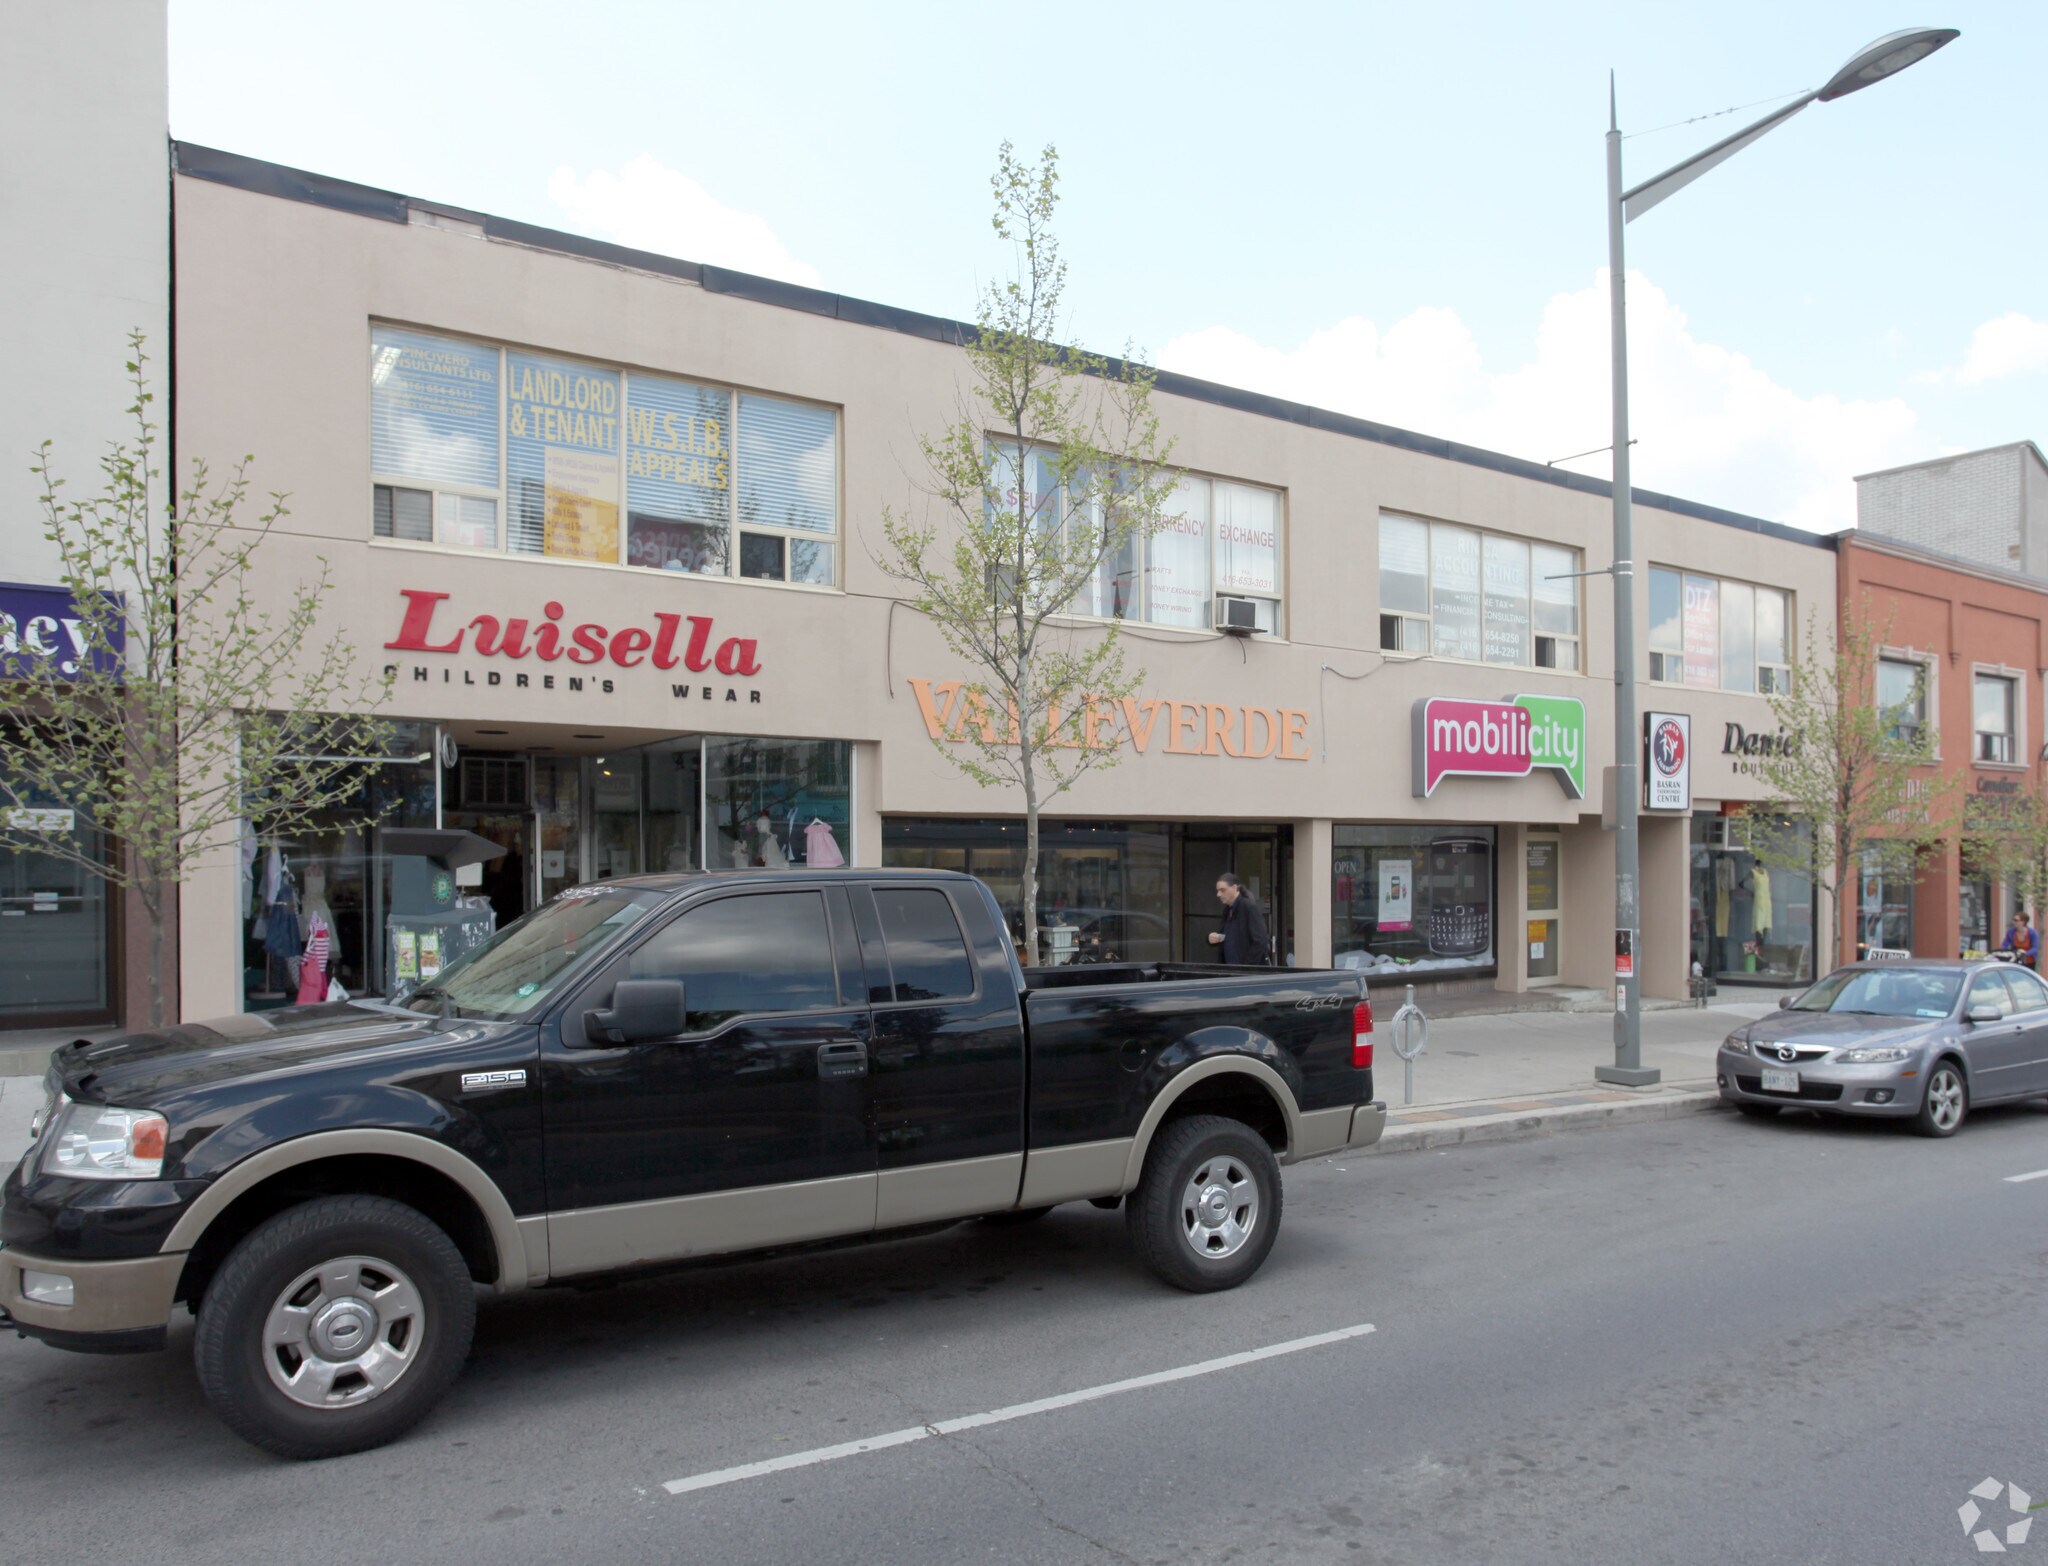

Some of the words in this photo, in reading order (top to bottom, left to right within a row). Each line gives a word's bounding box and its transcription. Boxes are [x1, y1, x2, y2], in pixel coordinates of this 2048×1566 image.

[384, 355, 466, 379] ONSULTANTS
[510, 365, 616, 414] LANDLORD
[510, 403, 527, 437] &
[531, 405, 617, 450] TENANT
[629, 407, 729, 461] W.S.I.B.
[629, 450, 727, 490] APPEALS
[1220, 524, 1275, 548] EXCHANGE
[1685, 585, 1712, 612] DTZ
[384, 588, 763, 676] Luisella
[384, 664, 615, 693] CHILDREN'S
[671, 684, 762, 704] WEAR
[1433, 709, 1579, 769] mobilicity
[1657, 780, 1681, 788] BASRAN
[1657, 794, 1681, 803] CENTRE
[1334, 860, 1357, 873] OPEN
[1295, 993, 1343, 1012] 4x4
